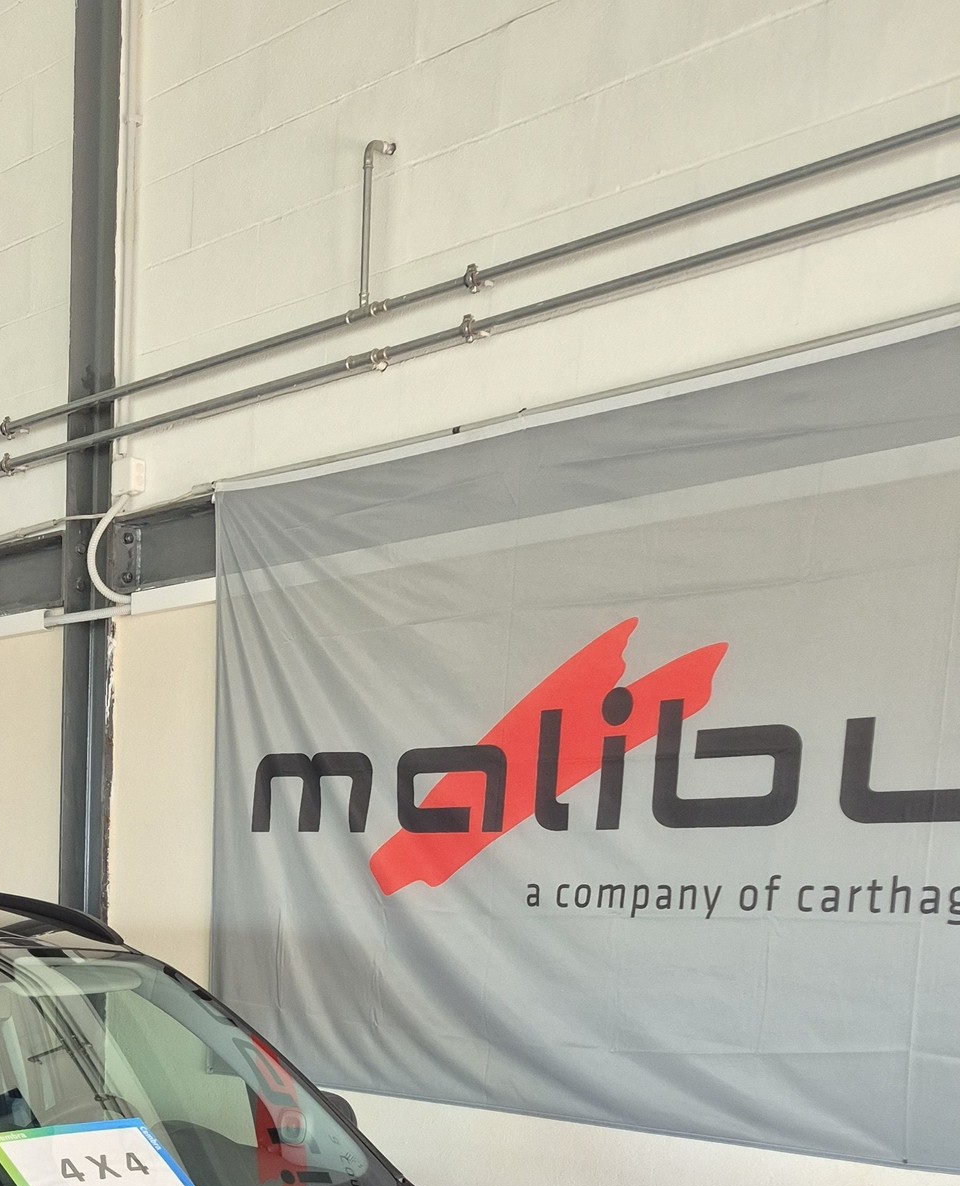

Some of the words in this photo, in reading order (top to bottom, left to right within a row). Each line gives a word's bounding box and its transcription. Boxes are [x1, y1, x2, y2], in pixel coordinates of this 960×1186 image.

[526, 883, 540, 907] a
[556, 883, 722, 919] company
[740, 875, 782, 912] of
[140, 1126, 162, 1151] Cembra
